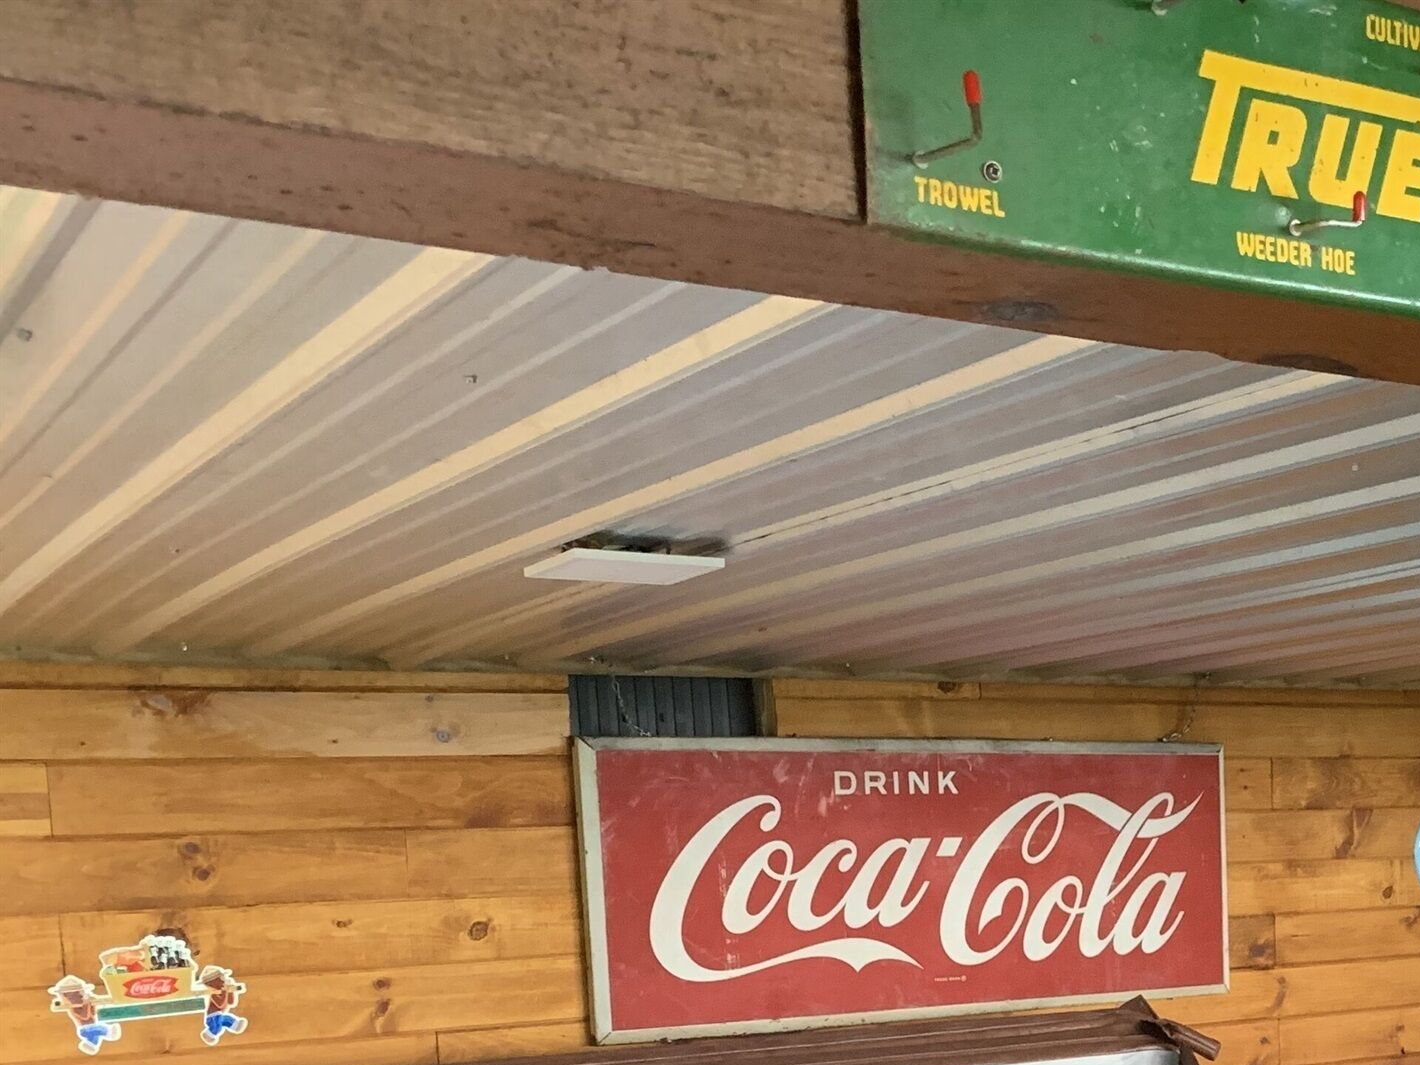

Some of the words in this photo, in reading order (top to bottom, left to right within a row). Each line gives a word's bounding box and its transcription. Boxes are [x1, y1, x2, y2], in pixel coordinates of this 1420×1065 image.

[914, 175, 1005, 218] TROWEL
[1236, 231, 1312, 267] WEEDER
[1320, 245, 1356, 276] HOE
[832, 770, 960, 797] DRINK
[649, 791, 1205, 983] Coca-Cola
